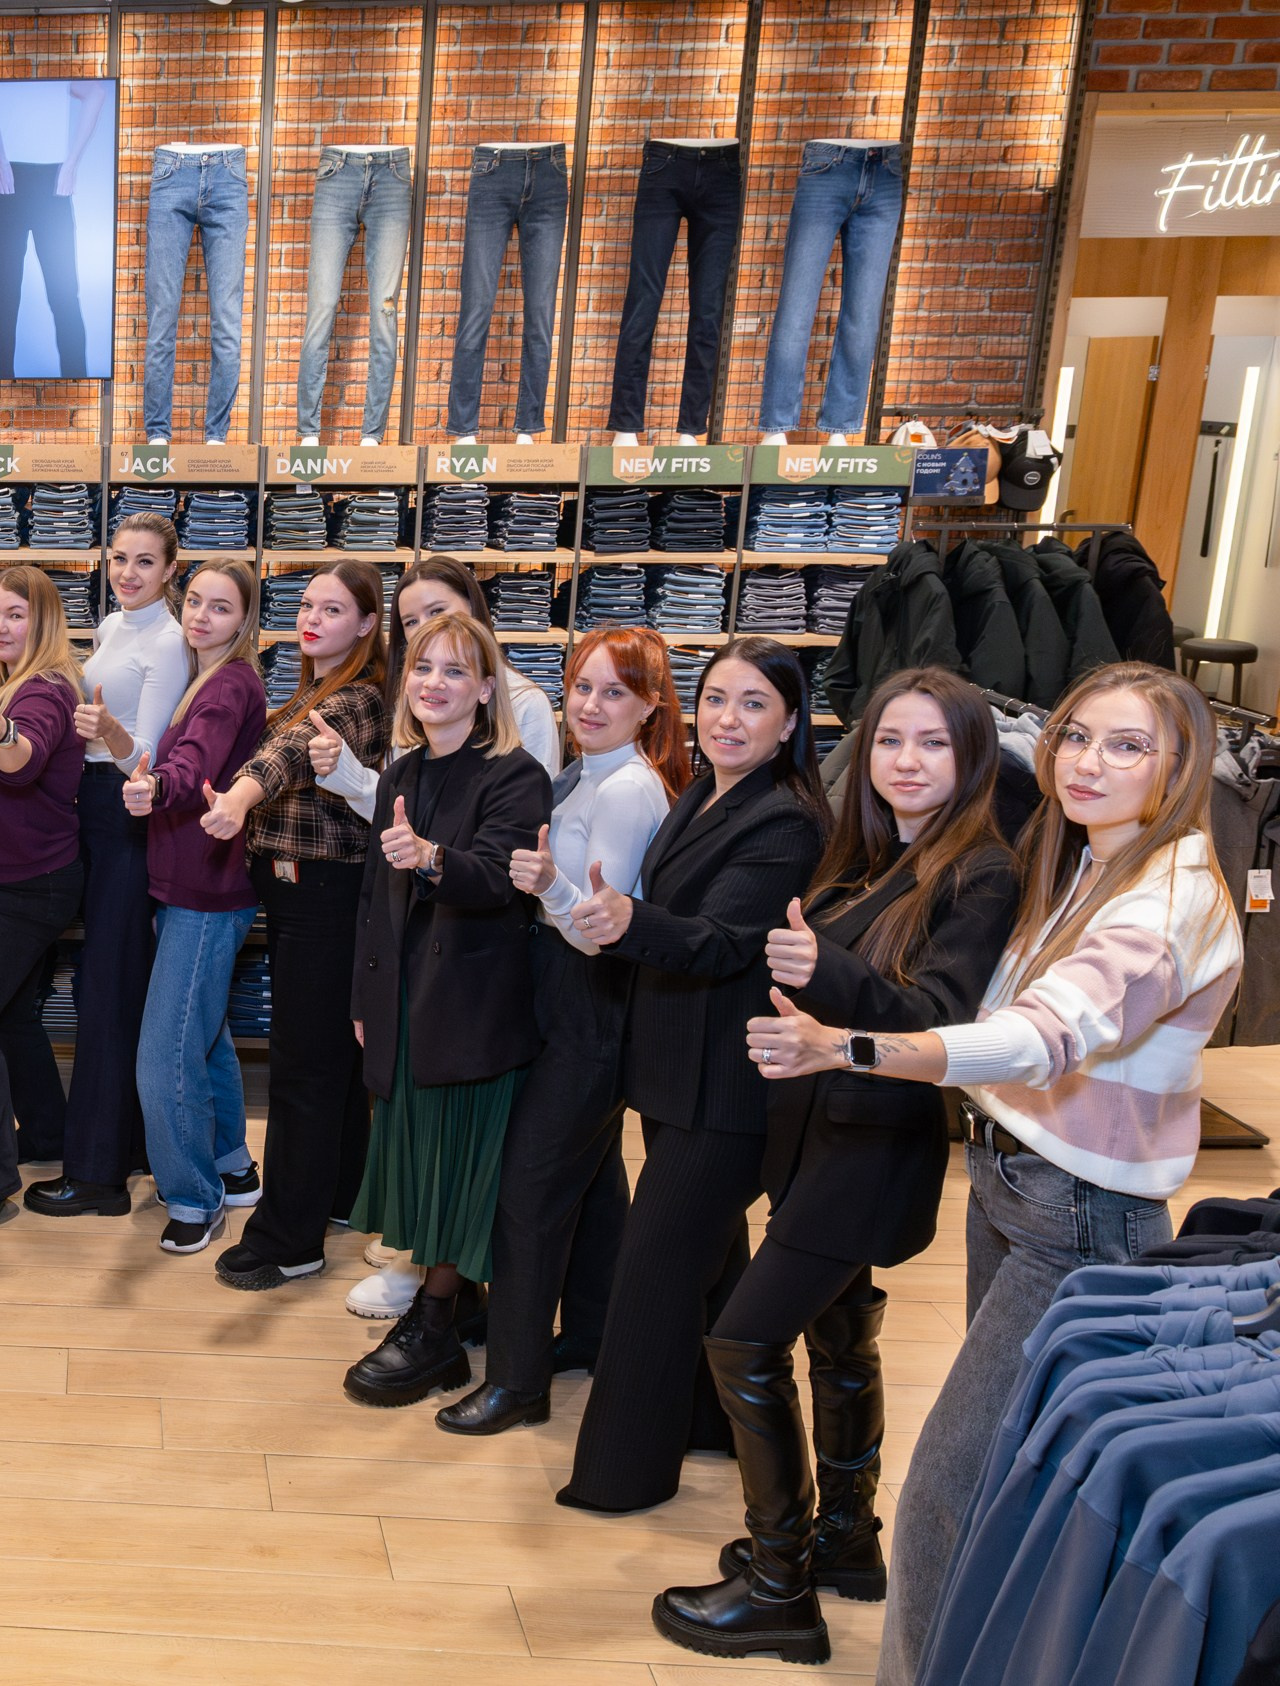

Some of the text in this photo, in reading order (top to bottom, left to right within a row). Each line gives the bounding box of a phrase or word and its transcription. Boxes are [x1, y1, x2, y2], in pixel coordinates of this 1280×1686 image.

[118, 457, 176, 473] JACK
[276, 458, 352, 474] DANNY
[436, 457, 497, 473] RYAN
[620, 457, 711, 473] NEW FITS
[785, 457, 878, 474] NEW FITS
